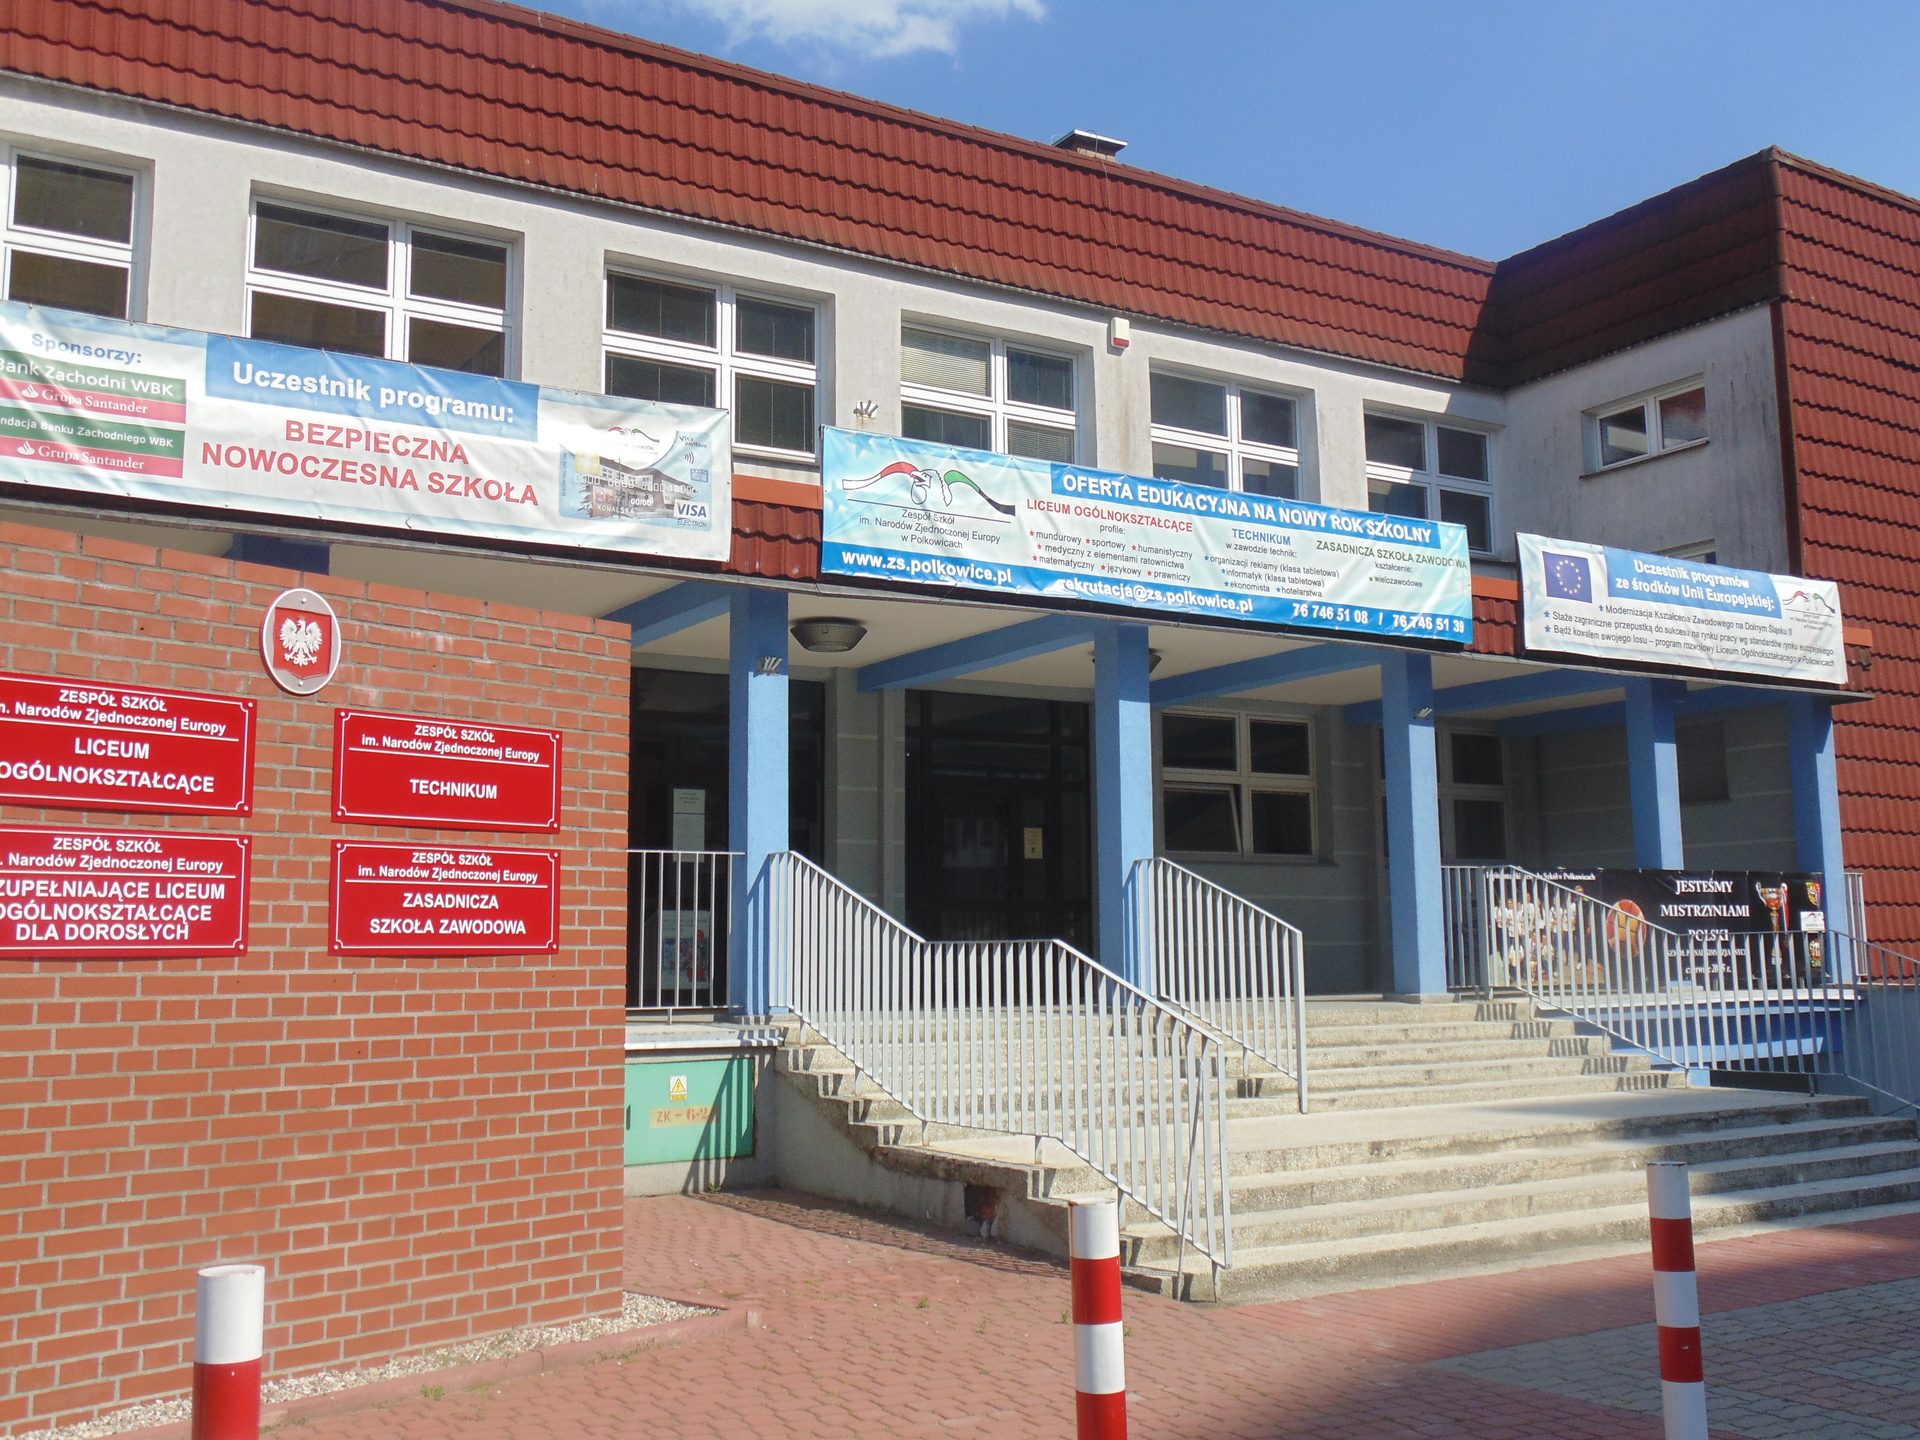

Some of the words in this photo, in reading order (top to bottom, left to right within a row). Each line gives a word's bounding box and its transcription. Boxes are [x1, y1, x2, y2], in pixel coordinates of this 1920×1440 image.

[31, 333, 142, 364] Sponsorzy:
[44, 364, 126, 390] Zachodni
[130, 378, 174, 397] WBK
[233, 361, 371, 402] Uczestnik
[380, 387, 514, 423] programu:
[41, 388, 83, 407] Grupa
[85, 395, 148, 414] Santander
[40, 421, 74, 435] Banku
[77, 426, 147, 444] Zachodniego
[149, 436, 174, 448] WBK
[285, 419, 470, 465] BEZPIECZNA
[38, 446, 79, 461] Grupa
[81, 452, 145, 470] Santander
[201, 442, 419, 491] NOWOCZESNA
[427, 472, 539, 506] SZKOŁA
[597, 504, 635, 515] KOWALSKA
[676, 502, 707, 518] VISA
[901, 509, 931, 522] Zespół
[933, 513, 955, 525] Szkół
[1027, 499, 1071, 515] LICEUM
[1074, 505, 1193, 533] OGÓLNOKSZTAŁCĄCE
[1063, 474, 1133, 500] OFERTA
[1137, 486, 1250, 518] EDUKACYJNA
[1253, 503, 1276, 522] NA
[1279, 507, 1327, 528] NOWY
[1330, 514, 1364, 534] ROK
[1366, 519, 1431, 543] SZKOLNY
[676, 519, 707, 528] ELECTRON
[859, 515, 872, 526] im.
[875, 518, 912, 531] Narodów
[915, 523, 970, 541] Zjednoczonej
[972, 531, 1000, 545] Europy
[1099, 523, 1126, 535] profile:
[910, 534, 963, 549] Polkowicach
[1036, 530, 1082, 545] mundurowy
[1091, 537, 1126, 551] sportowy
[1138, 544, 1193, 560] humanistyczny
[1231, 528, 1291, 546] TECHNIKUM
[1045, 544, 1085, 558] medyczny
[1093, 551, 1138, 563] elementami
[1140, 556, 1184, 570] ratownictwa
[1234, 543, 1268, 555] zawodzie
[1270, 547, 1297, 558] technik:
[1316, 540, 1375, 558] ZASADNICZA
[1376, 549, 1414, 563] SZKOŁA
[1416, 554, 1468, 569] ZAWODOWA
[842, 551, 1012, 585] www.zs.polkowice.pl
[1039, 555, 1095, 571] matematyczny
[1107, 563, 1142, 577] językowy
[1154, 570, 1191, 583] prawniczy
[1210, 555, 1249, 568] organizacji
[1250, 561, 1278, 573] reklamy
[1280, 564, 1301, 574] (klasa
[1303, 566, 1340, 579] tabletowa)
[1226, 568, 1263, 581] informatyk
[1265, 572, 1286, 583] (klasa
[1288, 576, 1325, 588] tabletowa)
[1375, 561, 1413, 574] kształcenie:
[1634, 559, 1690, 580] Uczestnik
[1691, 570, 1749, 589] programów
[1230, 581, 1270, 592] ekonomista
[1281, 586, 1323, 598] hotelarstwa
[1374, 575, 1423, 588] wielozawodowe
[1058, 577, 1253, 613] rekrutacja@zs.polkowice.pl
[1615, 578, 1629, 590] ze
[1632, 577, 1680, 596] środków
[1681, 585, 1704, 600] Unii
[1706, 589, 1776, 611] Europejskiej:
[1293, 603, 1309, 617] 76
[1312, 605, 1334, 620] 746
[1336, 608, 1350, 622] 51
[1354, 610, 1368, 624] 08
[1392, 614, 1407, 628] 76
[1409, 616, 1433, 630] 746
[1436, 617, 1450, 631] 51
[1453, 619, 1465, 633] 39
[1605, 605, 1653, 619] Modernizacja
[1654, 610, 1691, 623] Kształcenia
[1692, 616, 1734, 629] Zawodowego
[1745, 622, 1768, 633] Dolnym
[1769, 623, 1788, 636] Śląsku
[1553, 611, 1573, 622] Staże
[1574, 615, 1612, 628] zagraniczne
[1614, 621, 1653, 634] przepustką
[1654, 625, 1663, 633] do
[1665, 627, 1690, 637] sukcesu
[1701, 631, 1718, 642] rynku
[1719, 634, 1737, 645] pracy
[1739, 637, 1748, 645] wg
[1749, 637, 1782, 649] standardów
[1783, 640, 1798, 652] rynku
[1554, 624, 1572, 636] Bądź
[1573, 627, 1600, 639] kowalem
[1601, 633, 1631, 644] swojego
[1633, 635, 1648, 644] losu
[1655, 638, 1682, 649] program
[1683, 643, 1714, 654] rozwojowy
[1716, 645, 1739, 655] Liceum
[59, 689, 117, 707] ZESPÓŁ
[121, 694, 167, 712] SZKÓŁ
[14, 702, 82, 720] Narodów
[85, 708, 177, 731] Zjednoczonej
[180, 718, 226, 736] Europy
[414, 724, 458, 740] ZESPÓŁ
[461, 729, 496, 743] SZKÓŁ
[74, 737, 150, 759] LICEUM
[361, 734, 379, 747] im.
[382, 736, 432, 752] Narodów
[434, 741, 503, 760] Zjednoczonej
[505, 747, 540, 763] Europy
[0, 760, 215, 794] OGÓLNOKSZTAŁCĄCE
[409, 778, 498, 799] TECHNIKUM
[52, 837, 112, 852] ZESPÓŁ
[115, 839, 163, 854] SZKÓŁ
[8, 853, 76, 868] Narodów
[79, 855, 173, 873] Zjednoczonej
[176, 858, 223, 874] Europy
[411, 851, 456, 866] ZESPÓŁ
[458, 853, 493, 867] SZKÓŁ
[357, 865, 376, 877] im.
[379, 865, 430, 879] Narodów
[432, 867, 501, 884] Zjednoczonej
[503, 870, 538, 885] Europy
[1675, 878, 1734, 895] JESTEŚMY
[155, 882, 225, 900] LICEUM
[402, 893, 499, 910] ZASADNICZA
[1659, 904, 1750, 918] MISTRZYNIAMI
[15, 923, 60, 941] DLA
[64, 924, 189, 941] DOROSŁYCH
[369, 918, 435, 934] SZKOŁA
[438, 919, 527, 935] ZAWODOWA
[1687, 929, 1729, 941] POLSKI
[656, 1110, 671, 1123] ZK
